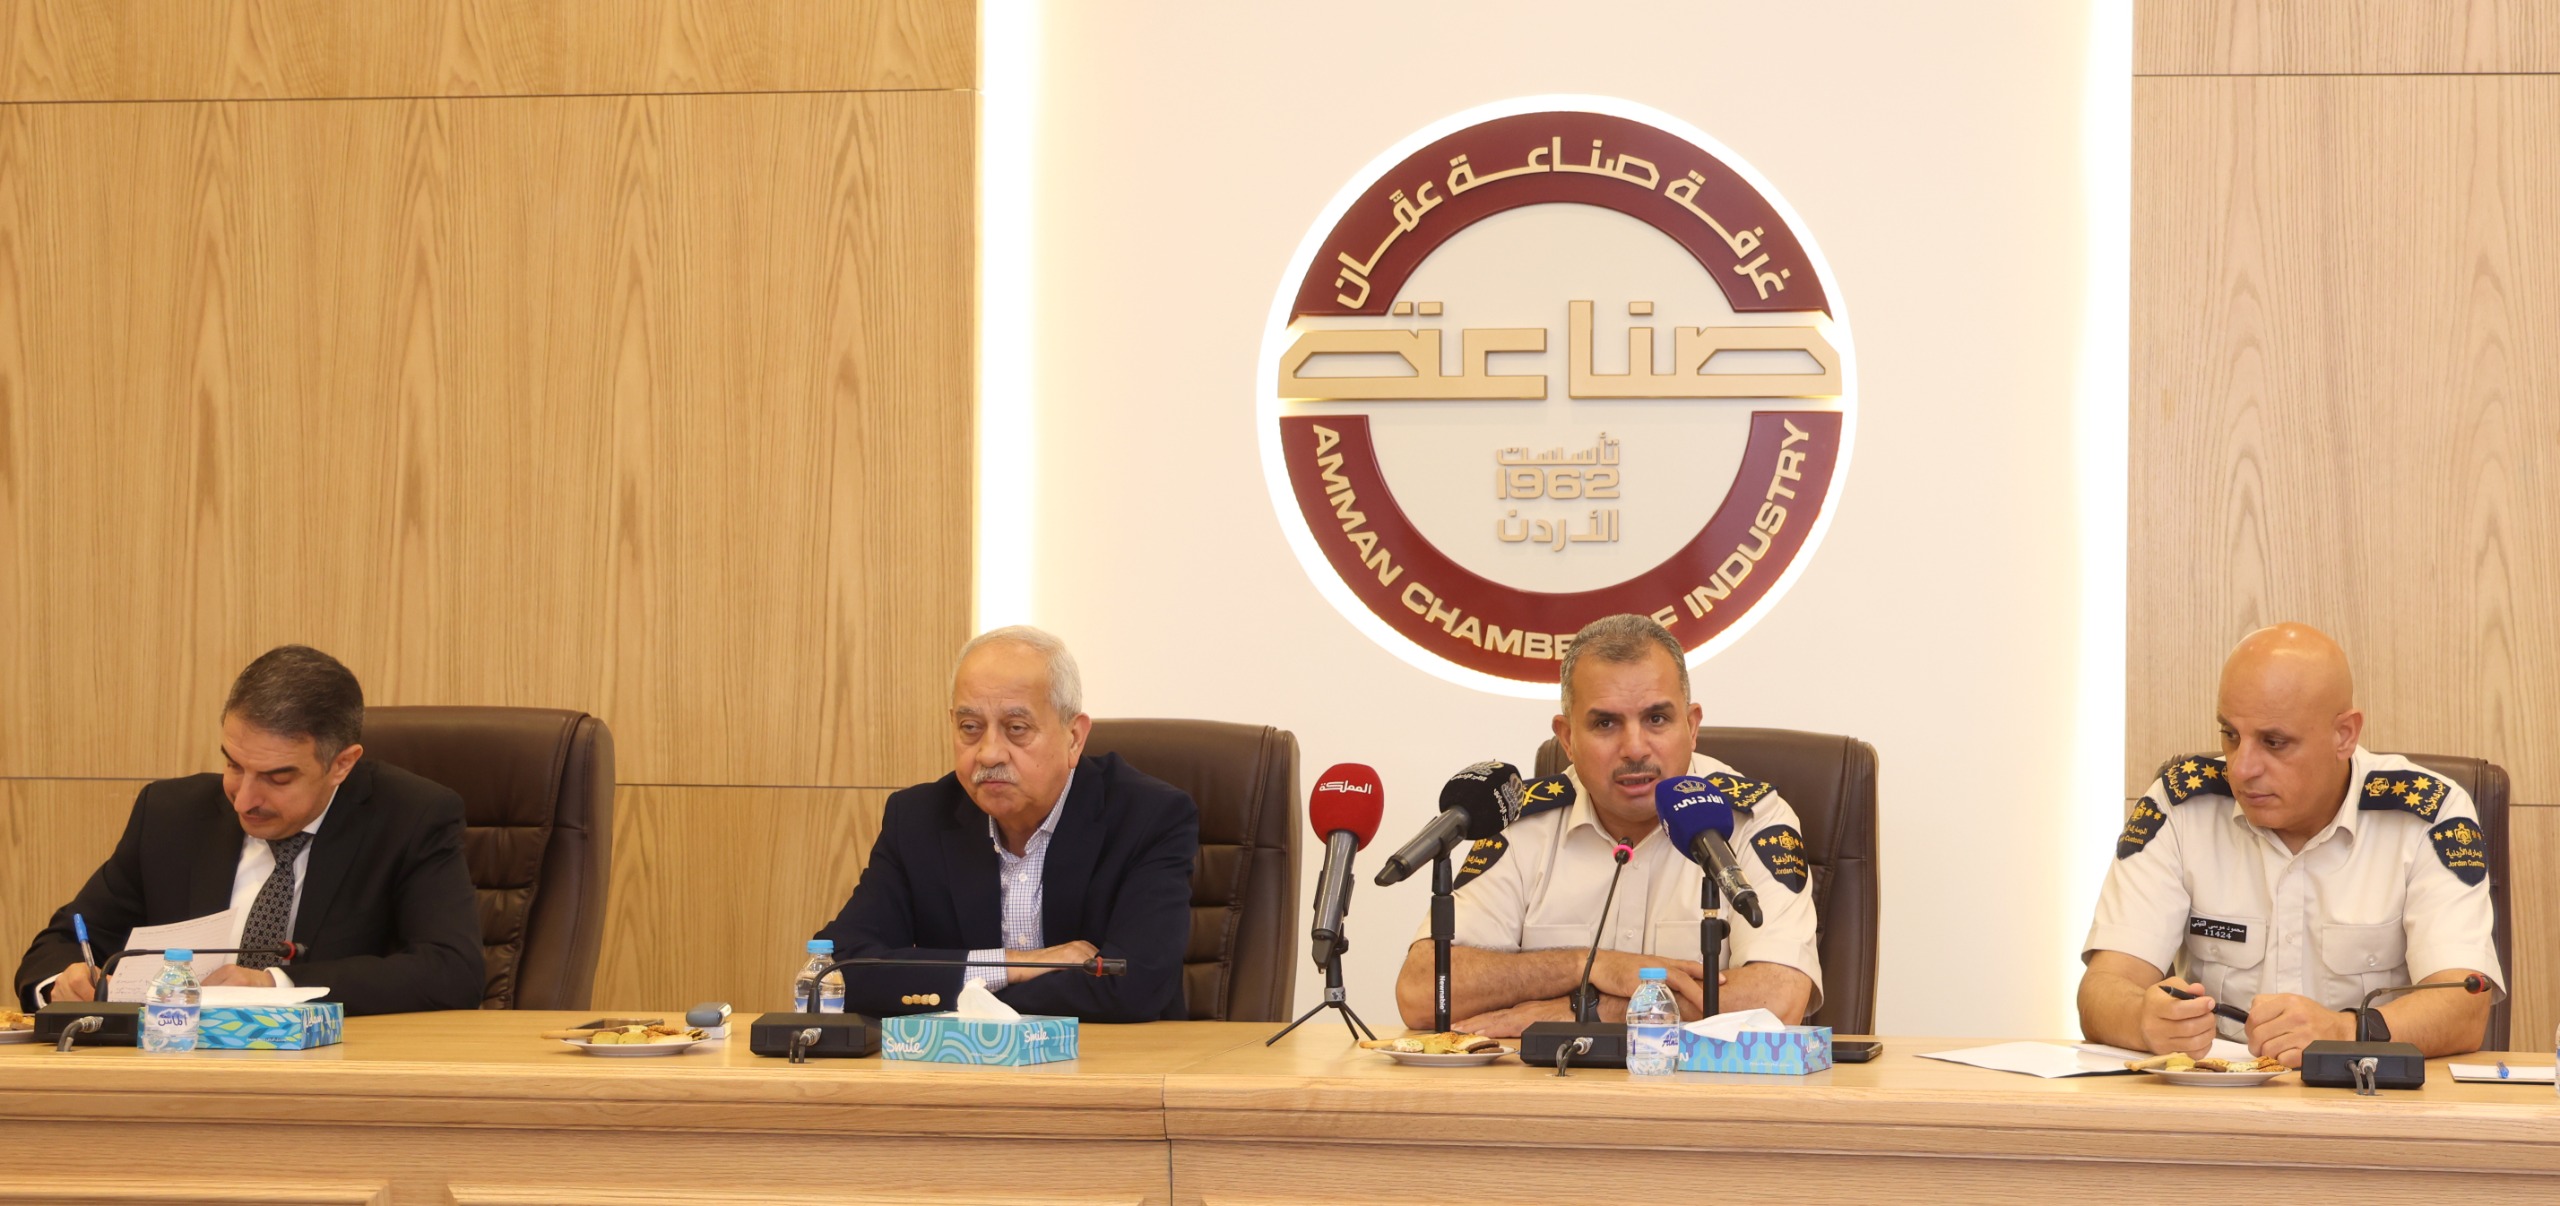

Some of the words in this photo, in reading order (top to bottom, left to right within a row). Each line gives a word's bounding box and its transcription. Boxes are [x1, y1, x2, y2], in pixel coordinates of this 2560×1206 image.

[1446, 136, 1660, 196] صناعة
[1664, 169, 1791, 300] غرفة
[1277, 300, 1843, 400] صناعة
[1496, 431, 1620, 466] تأسست
[1496, 467, 1620, 499] 1962
[1313, 424, 1404, 587] AMMAN
[1401, 581, 1575, 661] CHAMBE
[1650, 605, 1679, 628] F
[1683, 418, 1810, 619] INDUSTRY
[1497, 508, 1619, 552] الأردن
[1319, 780, 1373, 795] المملكة
[2204, 929, 2232, 940] 11424
